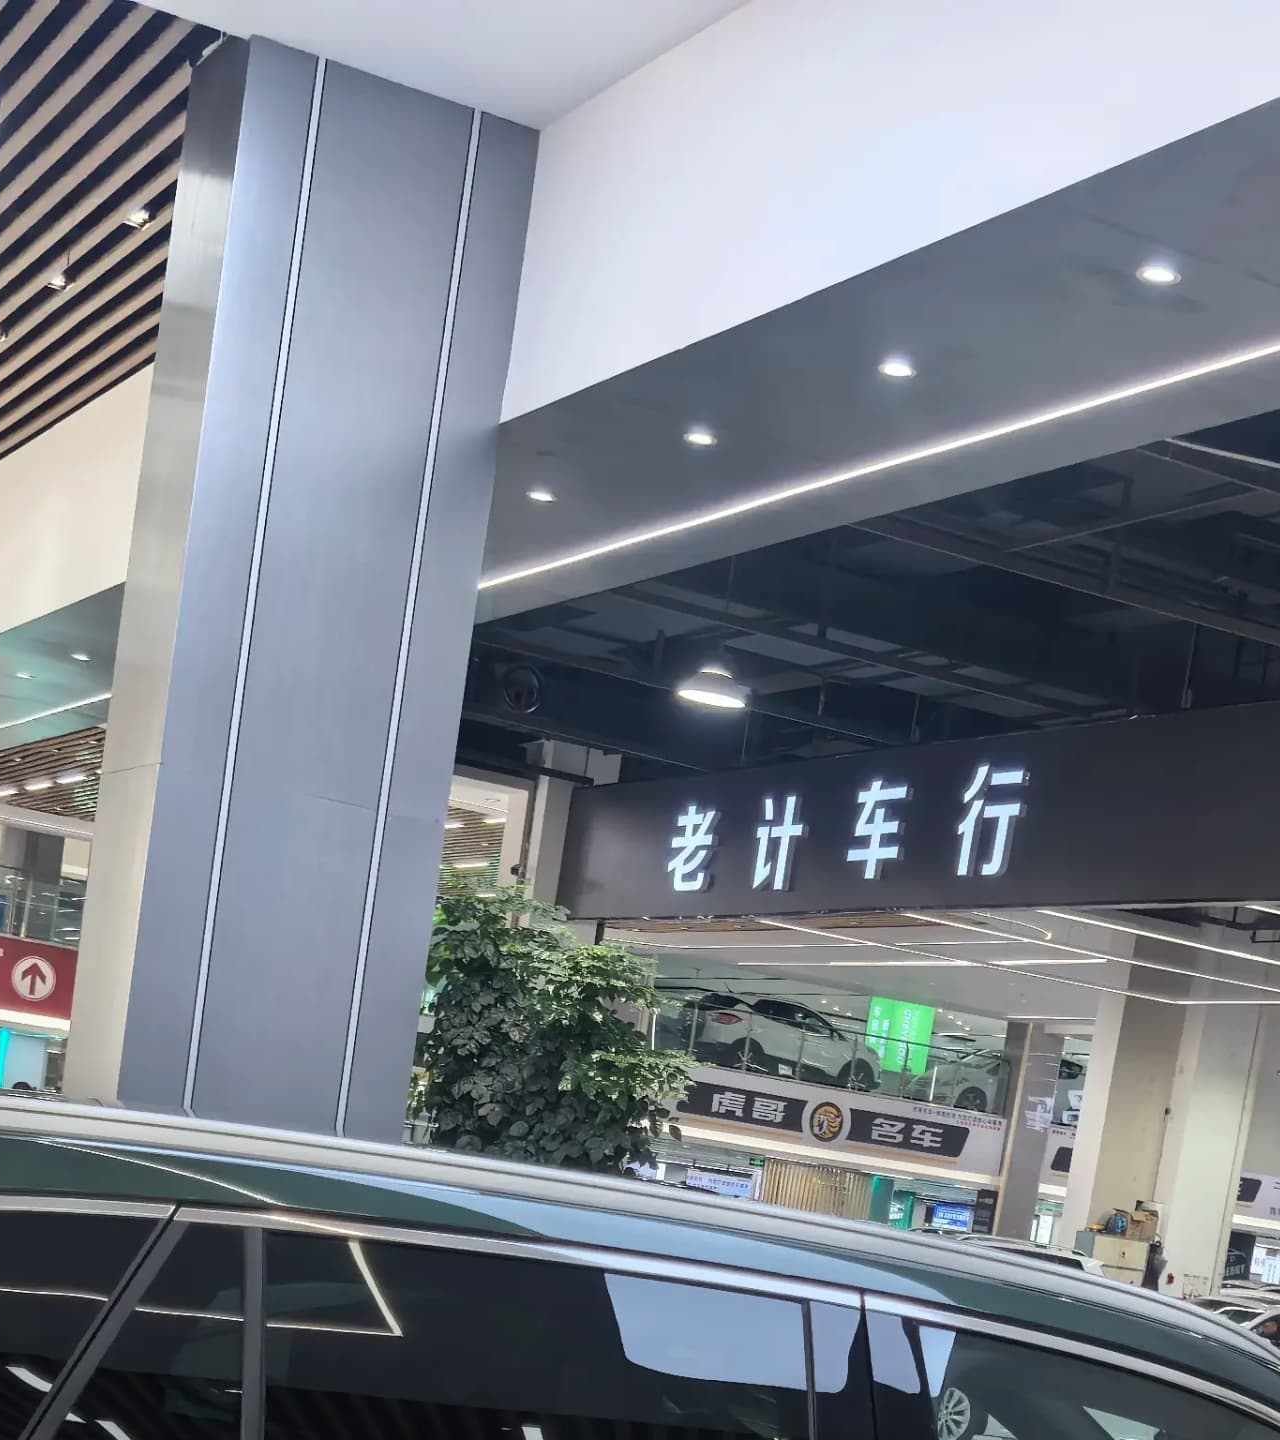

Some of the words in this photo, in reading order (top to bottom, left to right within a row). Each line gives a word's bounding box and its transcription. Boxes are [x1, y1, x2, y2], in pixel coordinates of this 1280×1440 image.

[667, 764, 1028, 893] 老计车行
[710, 1090, 787, 1125] 虎哥
[871, 1117, 943, 1150] 名车
